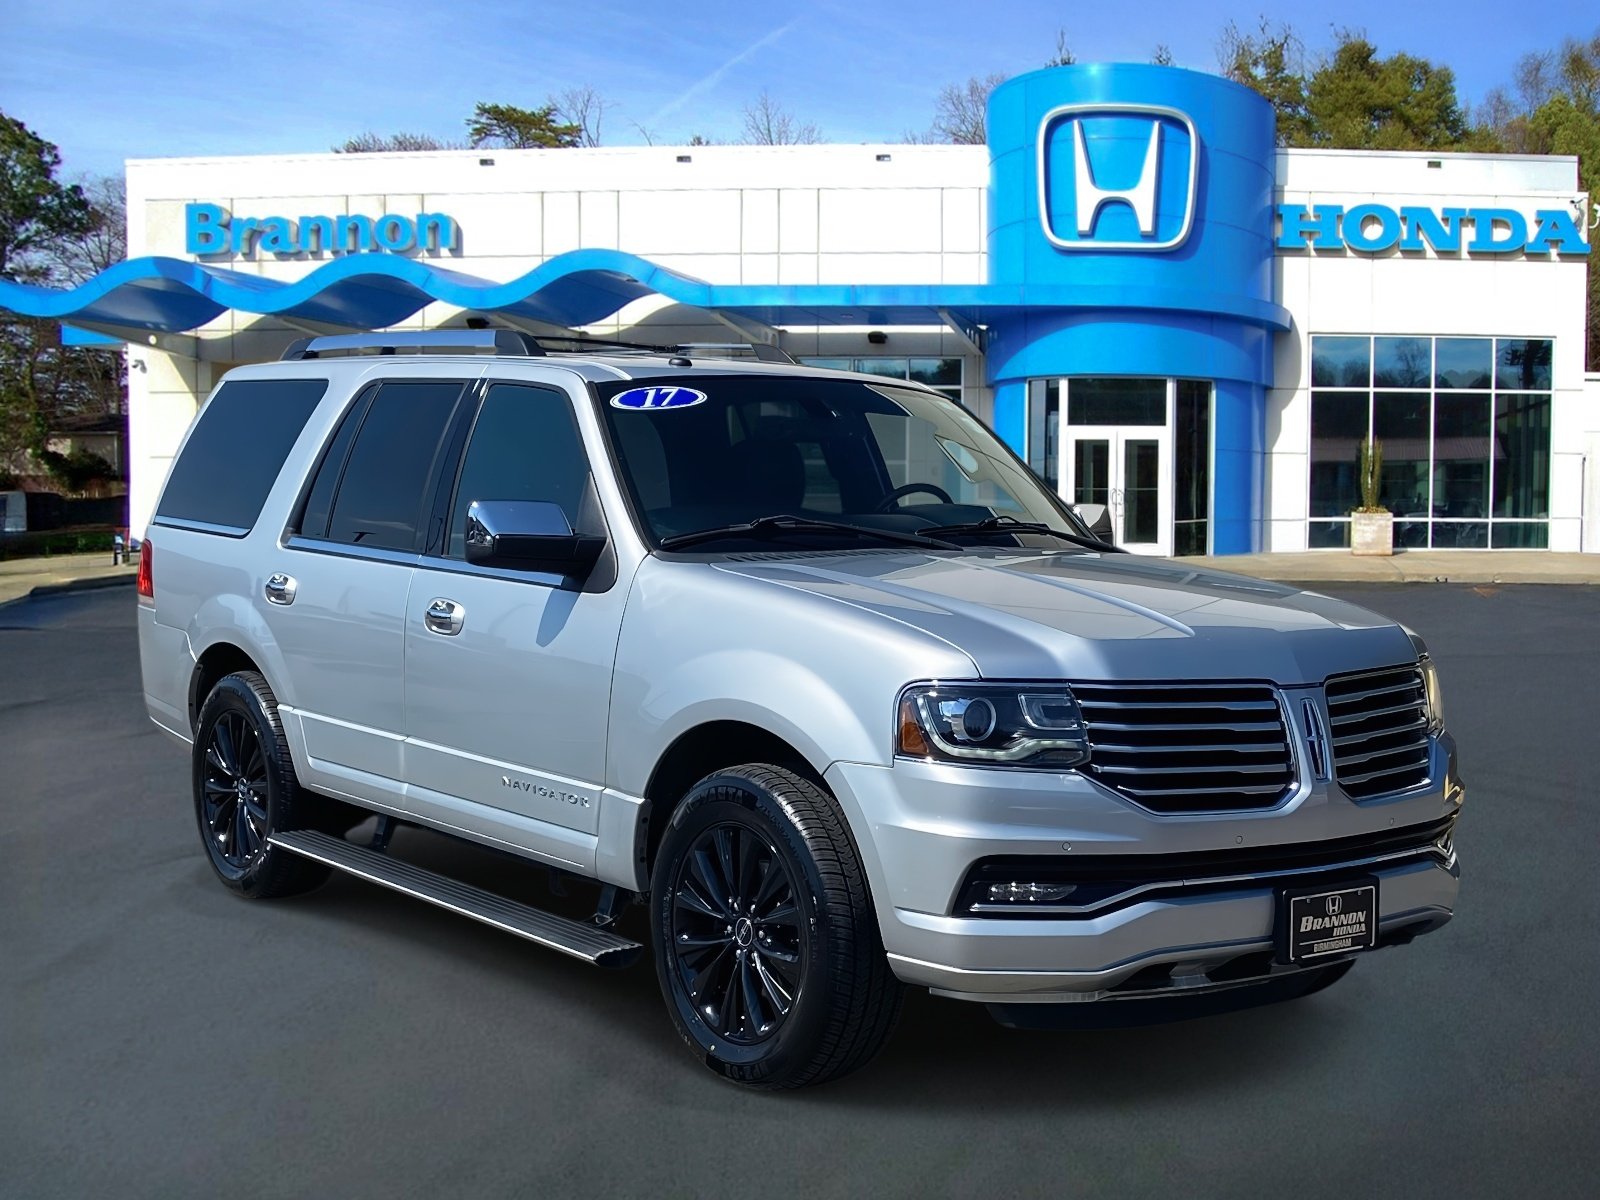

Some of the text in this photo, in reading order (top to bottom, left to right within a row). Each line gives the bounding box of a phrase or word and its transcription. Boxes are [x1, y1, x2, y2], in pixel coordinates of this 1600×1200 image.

[186, 202, 460, 254] Brannon
[1277, 204, 1591, 254] HONDA
[640, 388, 680, 408] 17
[501, 775, 590, 808] NAVIGATOR
[1300, 911, 1367, 932] BRANNON
[1333, 923, 1366, 936] HONDA
[1313, 938, 1352, 952] BIRMINGHAM
